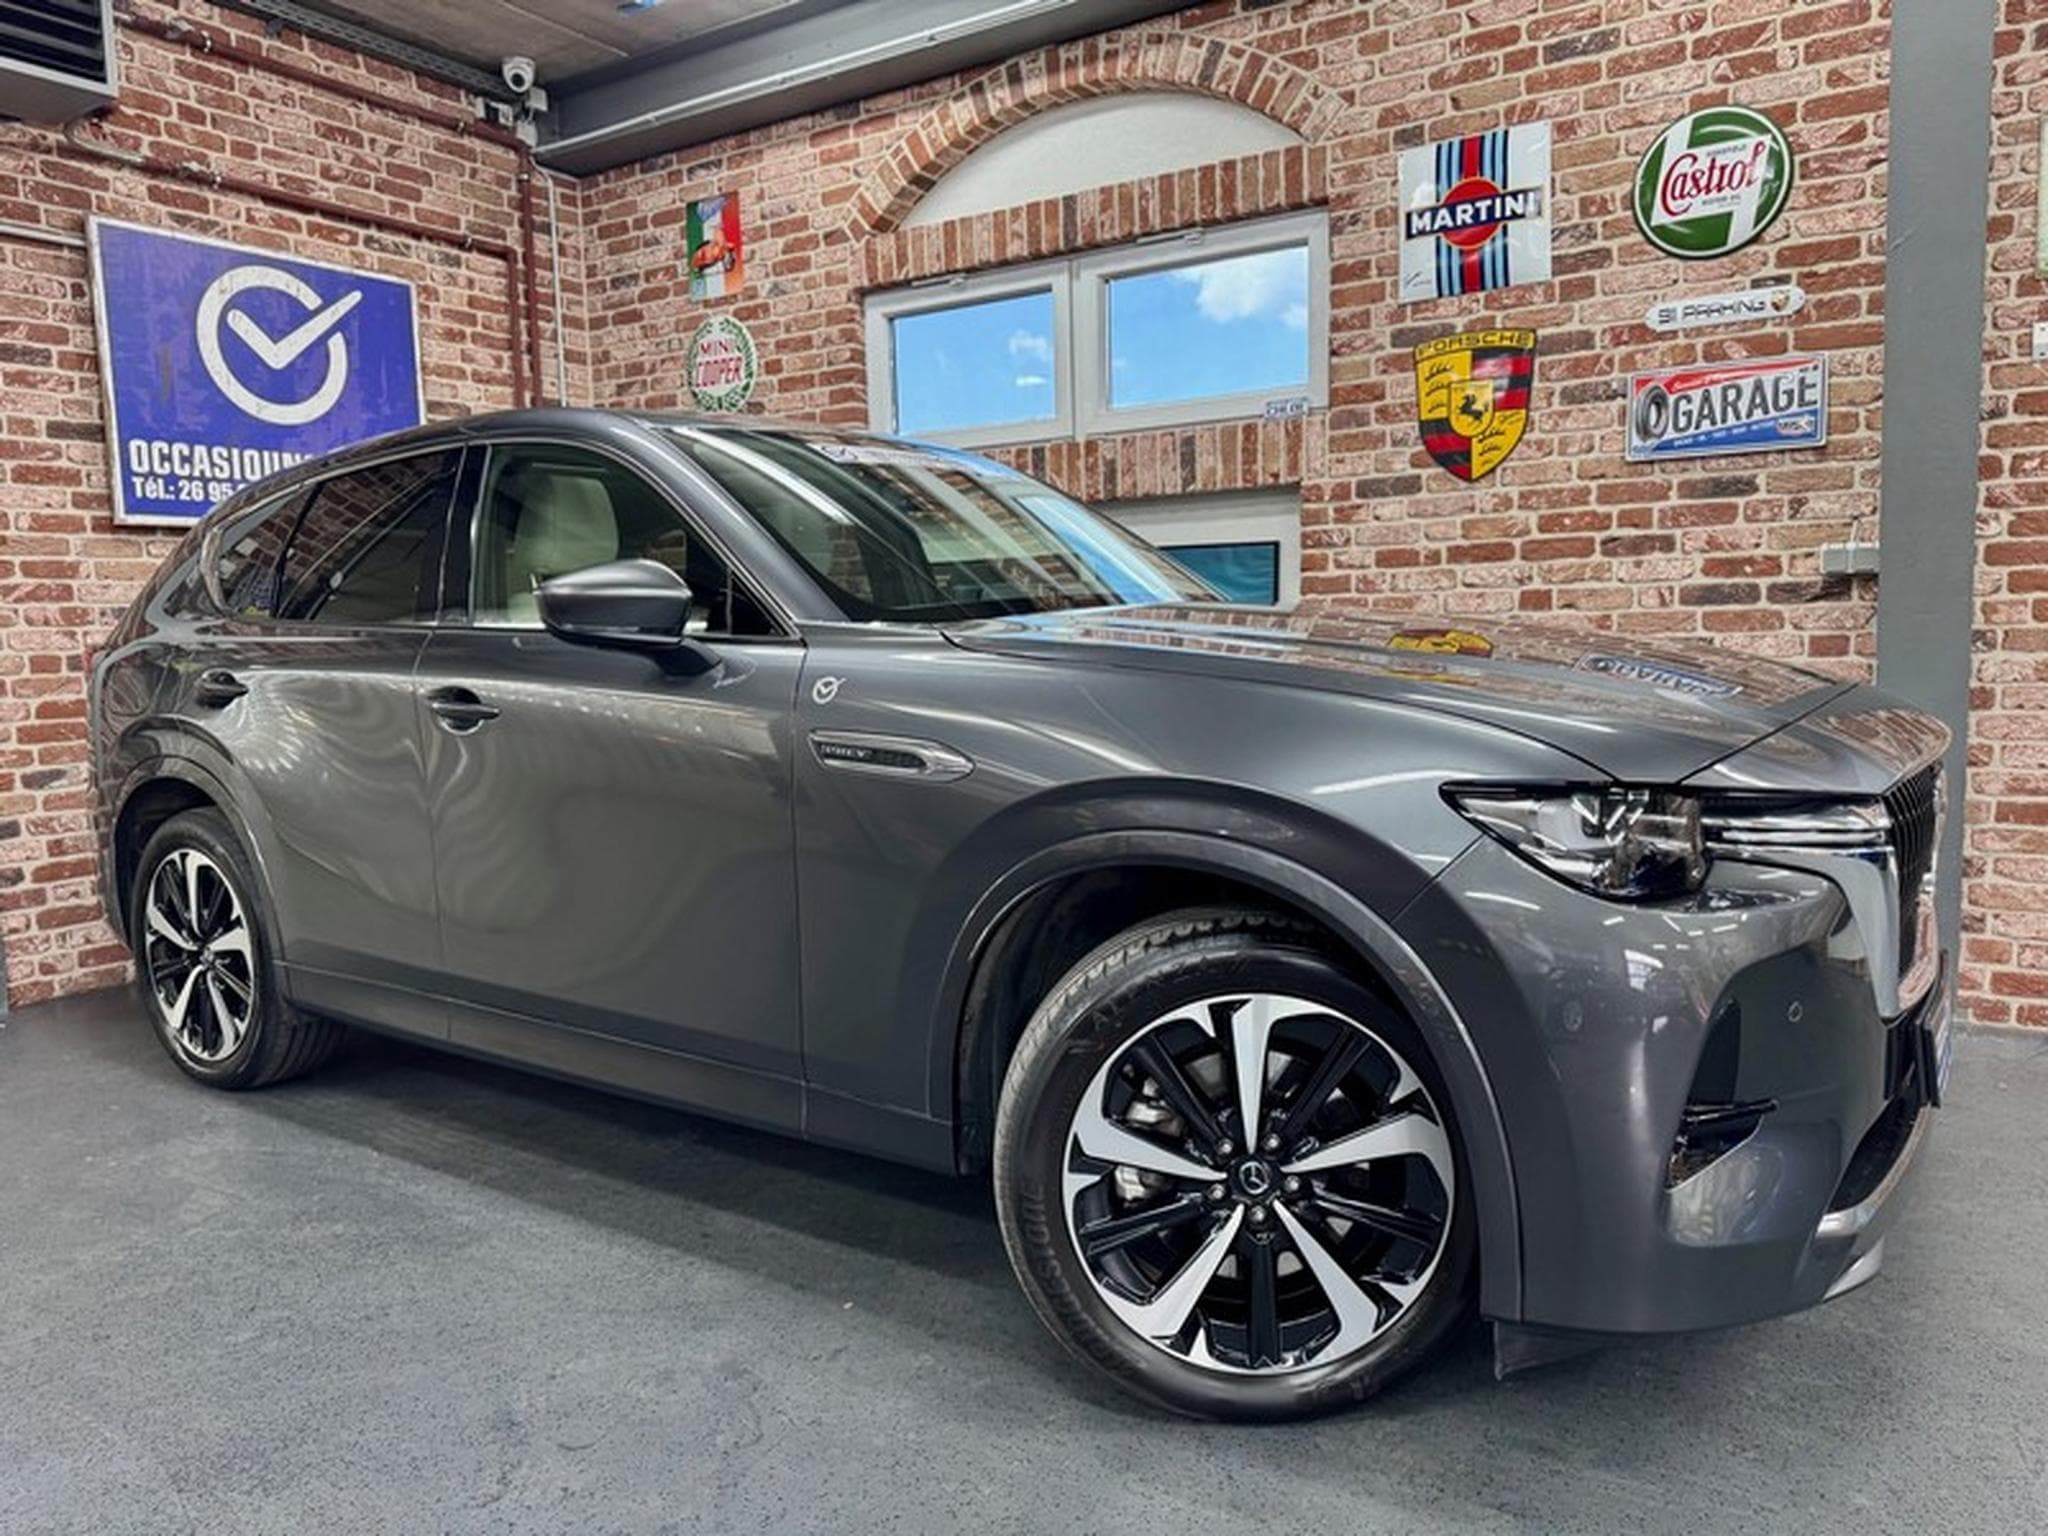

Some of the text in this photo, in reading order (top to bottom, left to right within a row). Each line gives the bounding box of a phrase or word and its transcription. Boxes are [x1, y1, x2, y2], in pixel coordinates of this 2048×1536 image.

[1661, 141, 1766, 217] Castrol
[1411, 191, 1536, 235] MARTINI
[1682, 300, 1766, 319] PARKING
[1418, 331, 1532, 356] PORSCHE
[1672, 364, 1820, 434] GARAGE
[128, 438, 314, 482] OCCASIOU
[178, 481, 205, 501] 26
